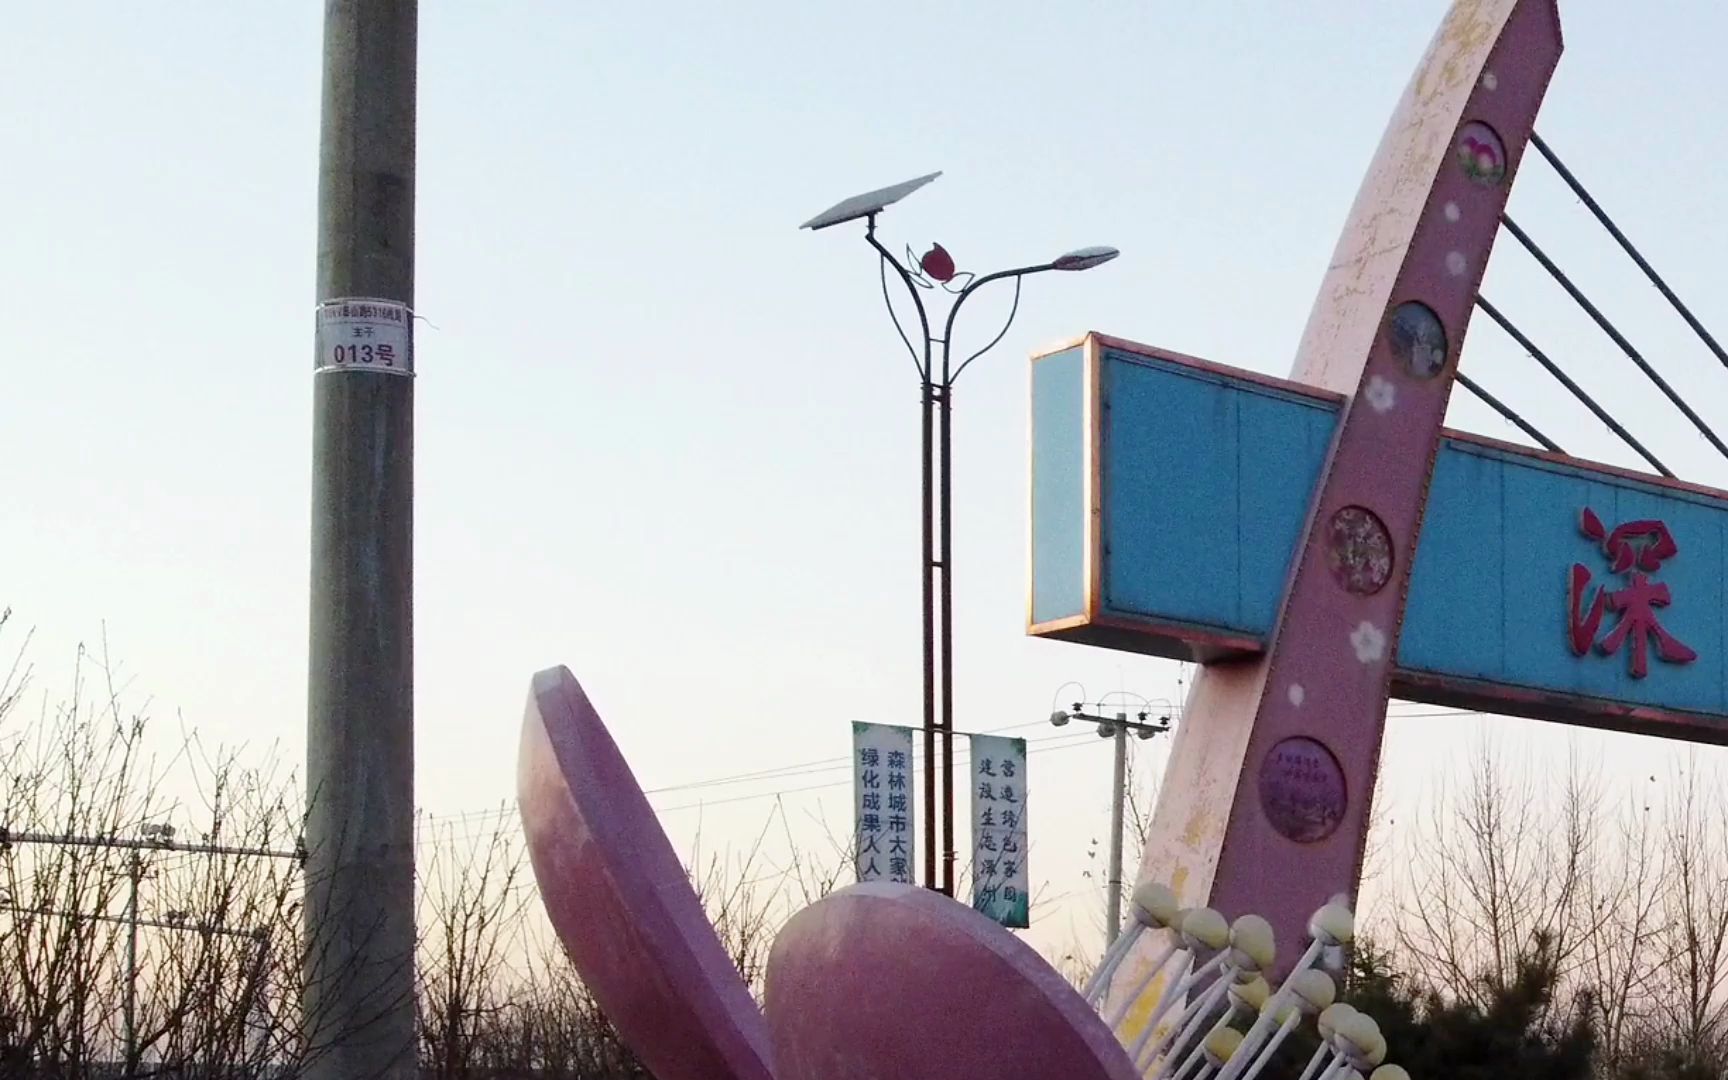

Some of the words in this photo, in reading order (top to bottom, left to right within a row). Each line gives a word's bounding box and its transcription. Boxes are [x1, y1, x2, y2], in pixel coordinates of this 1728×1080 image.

[334, 343, 396, 367] 013号
[861, 747, 882, 882] 绿化成果人人
[887, 749, 908, 882] 森林城市大家
